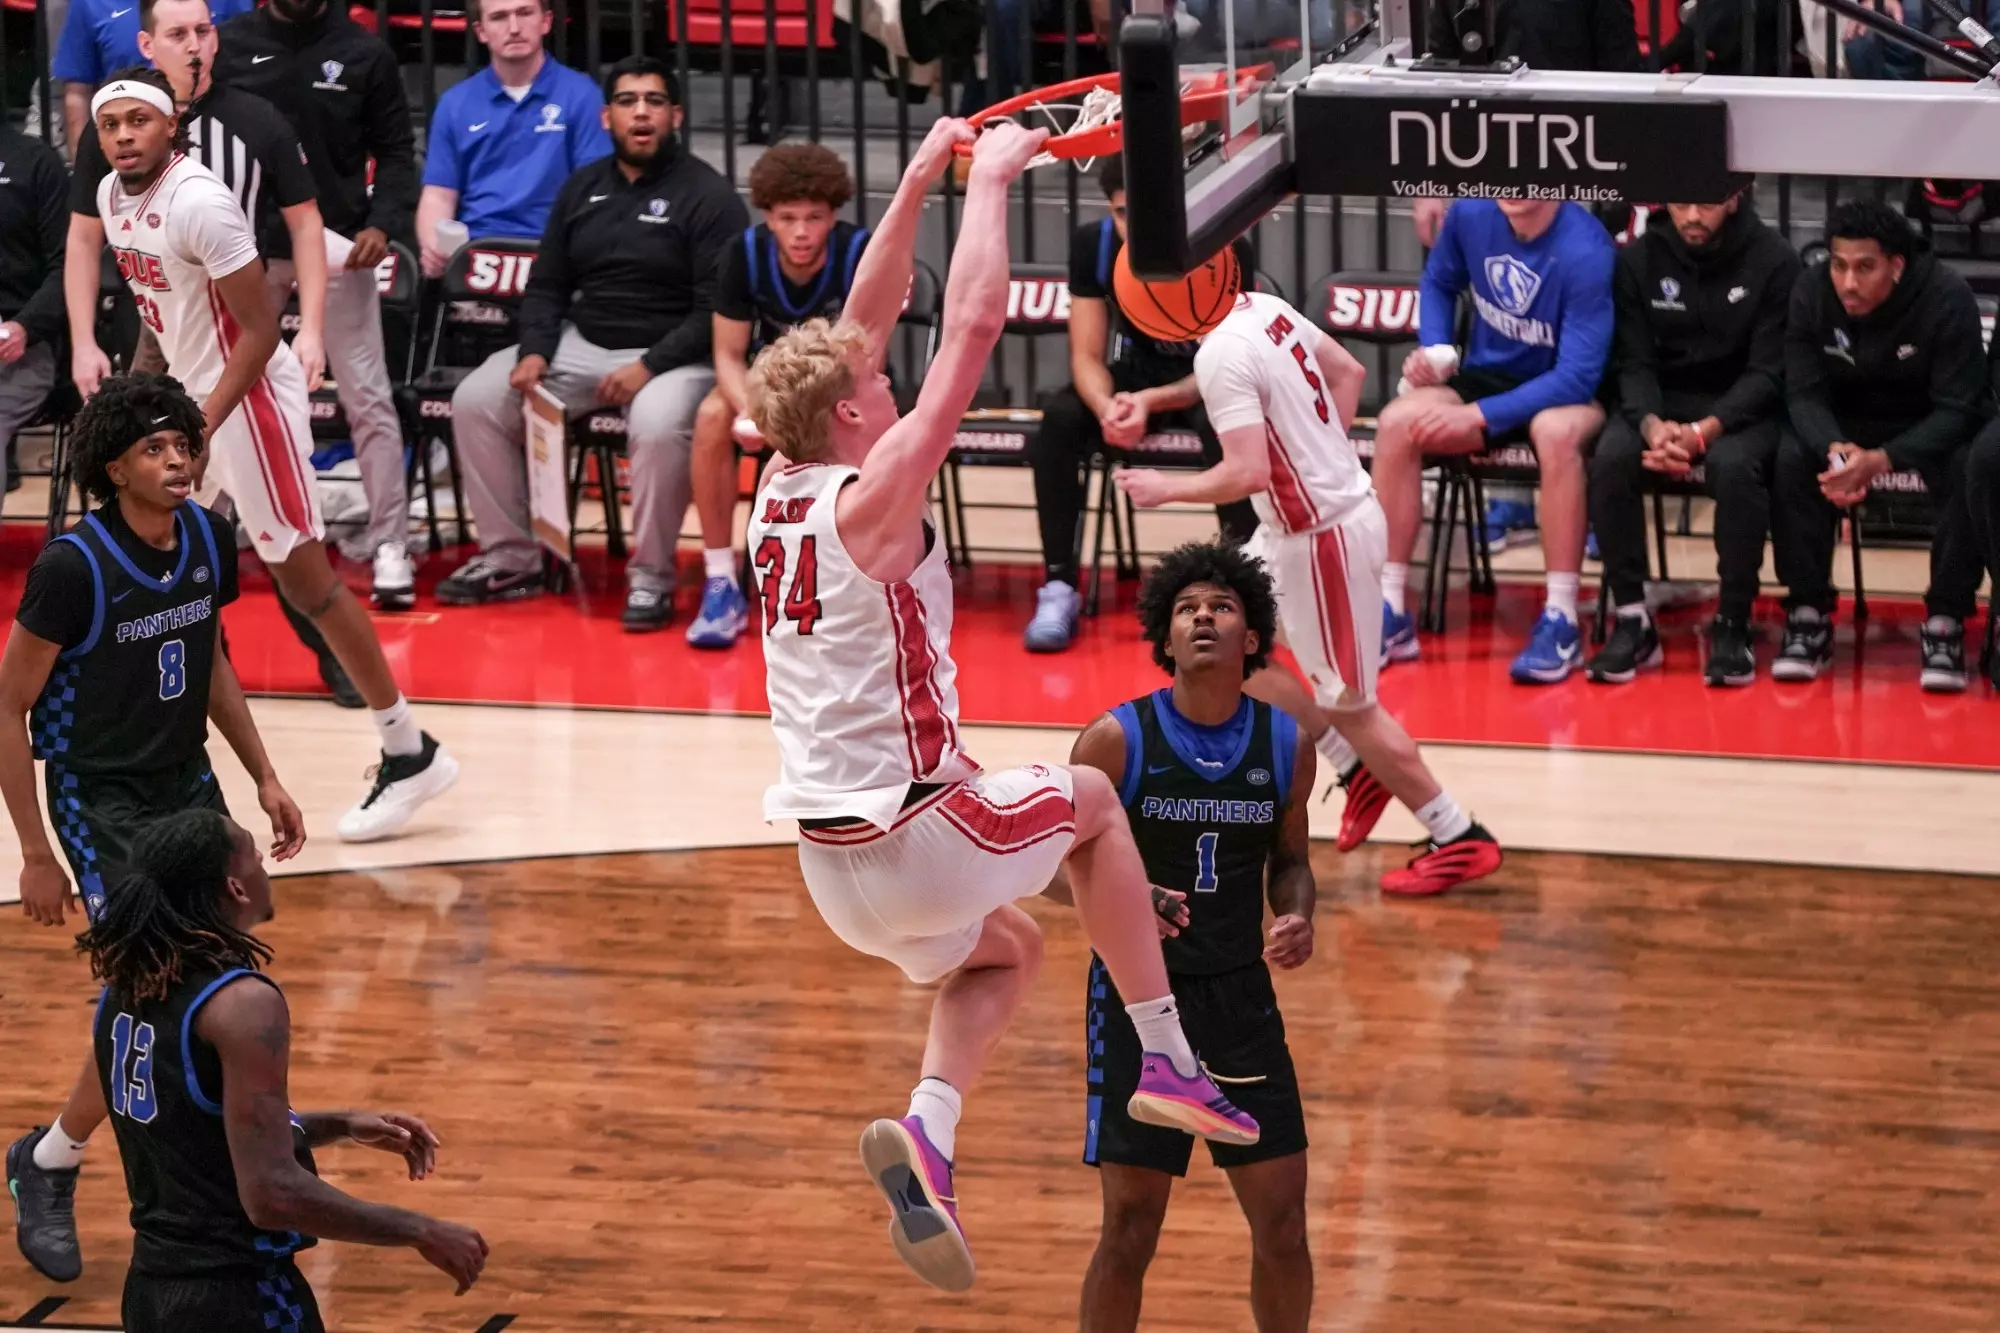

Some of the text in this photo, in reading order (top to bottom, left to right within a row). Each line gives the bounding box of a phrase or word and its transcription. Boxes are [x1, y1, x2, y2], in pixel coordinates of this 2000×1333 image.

[1392, 181, 1624, 202] Vodka. Seltzer. Real Juice.
[1290, 342, 1330, 424] 5
[755, 534, 823, 636] 34
[116, 594, 212, 643] PANTHERS
[158, 638, 186, 701] 8
[1141, 796, 1274, 823] PANTHERS
[1194, 832, 1220, 893] 1
[110, 1011, 158, 1124] 13
